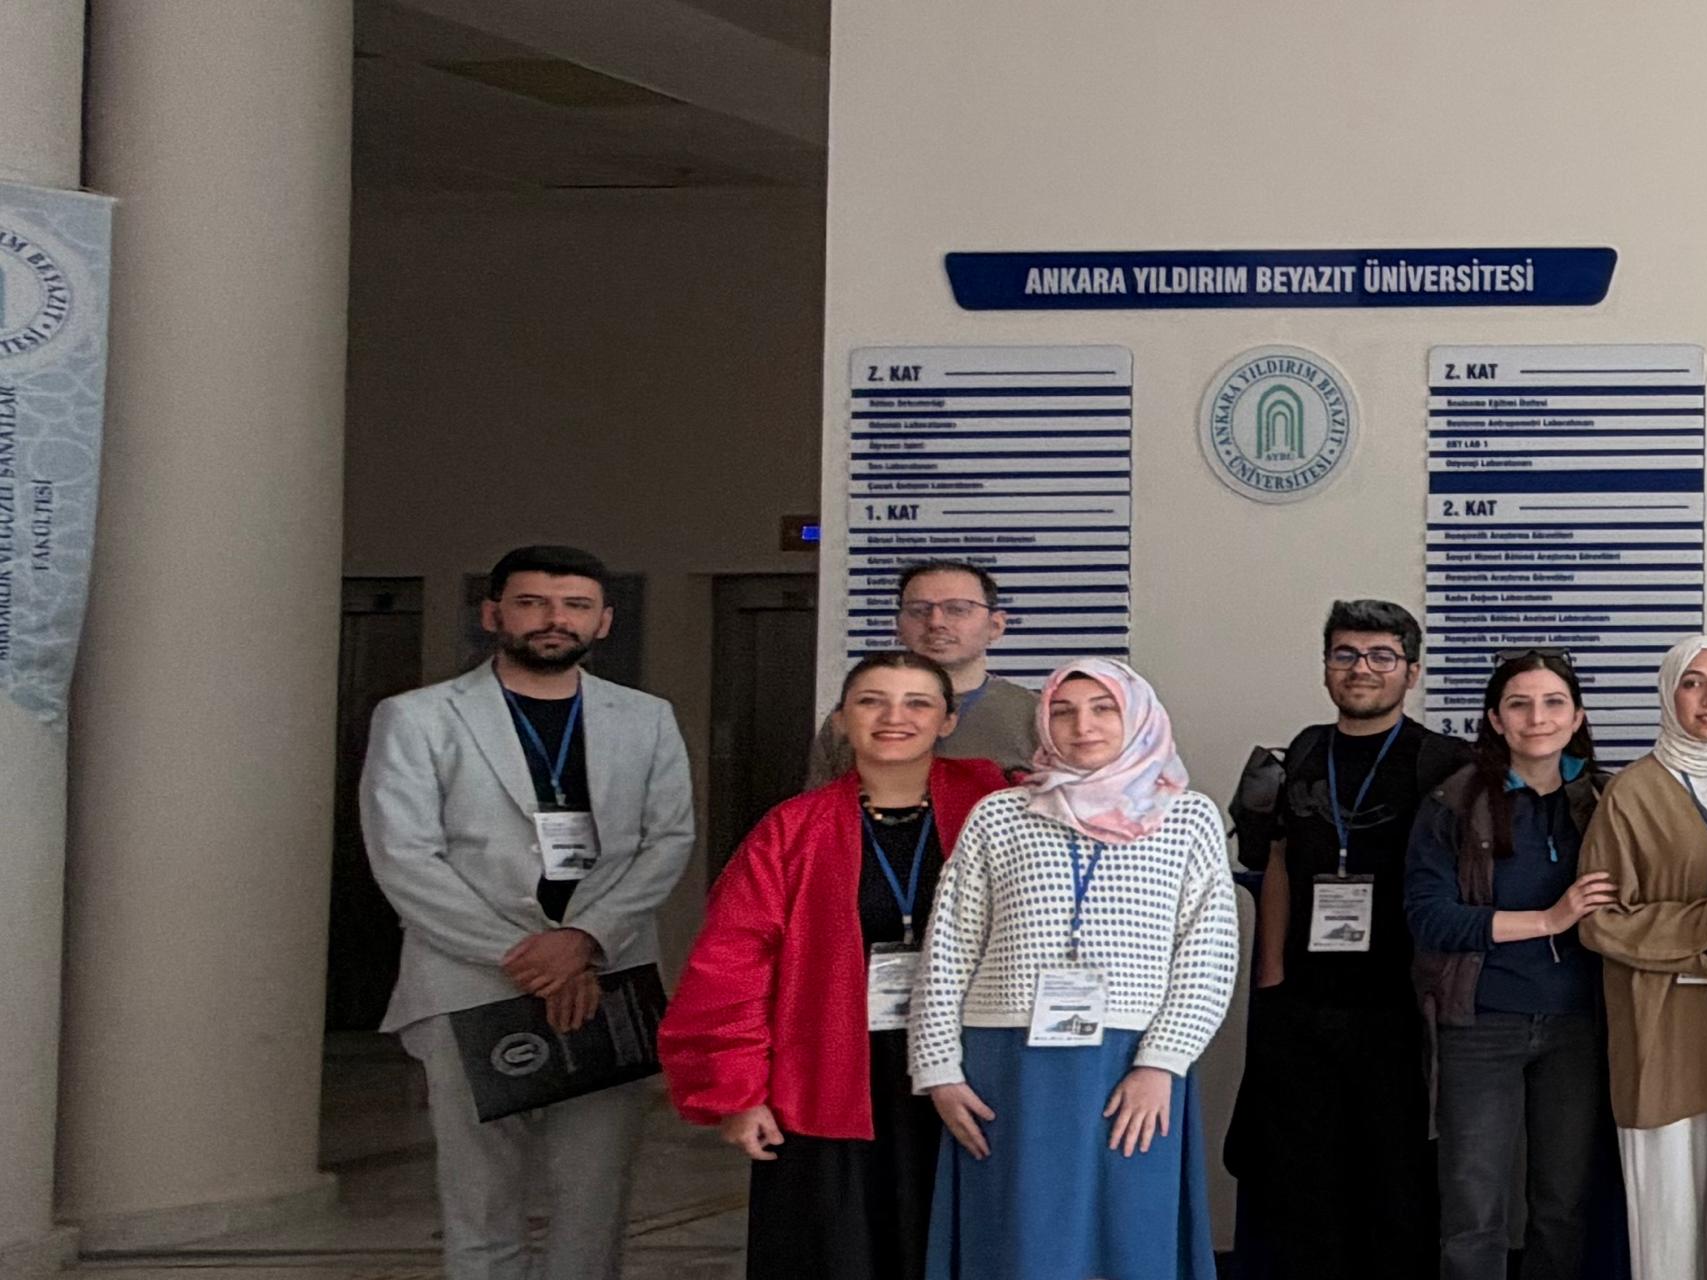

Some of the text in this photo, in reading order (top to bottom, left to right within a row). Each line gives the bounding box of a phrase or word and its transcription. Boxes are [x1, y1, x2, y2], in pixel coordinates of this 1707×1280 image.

[1025, 259, 1533, 294] ANKARA YILDIRIM BEYAZIT ÜNİVERSİTESİ
[868, 366, 922, 381] Z. KAT
[1445, 364, 1498, 380] Z. KAT
[1215, 359, 1345, 447] ANKARA YILDIRIM BEYAZIT
[1228, 455, 1332, 489] ÜNİVERSİTESİ
[865, 505, 919, 520] 1. KAT
[1443, 500, 1497, 516] 2. KAT
[31, 480, 53, 571] FAKÜLTESİ
[1440, 718, 1457, 736] 3.
